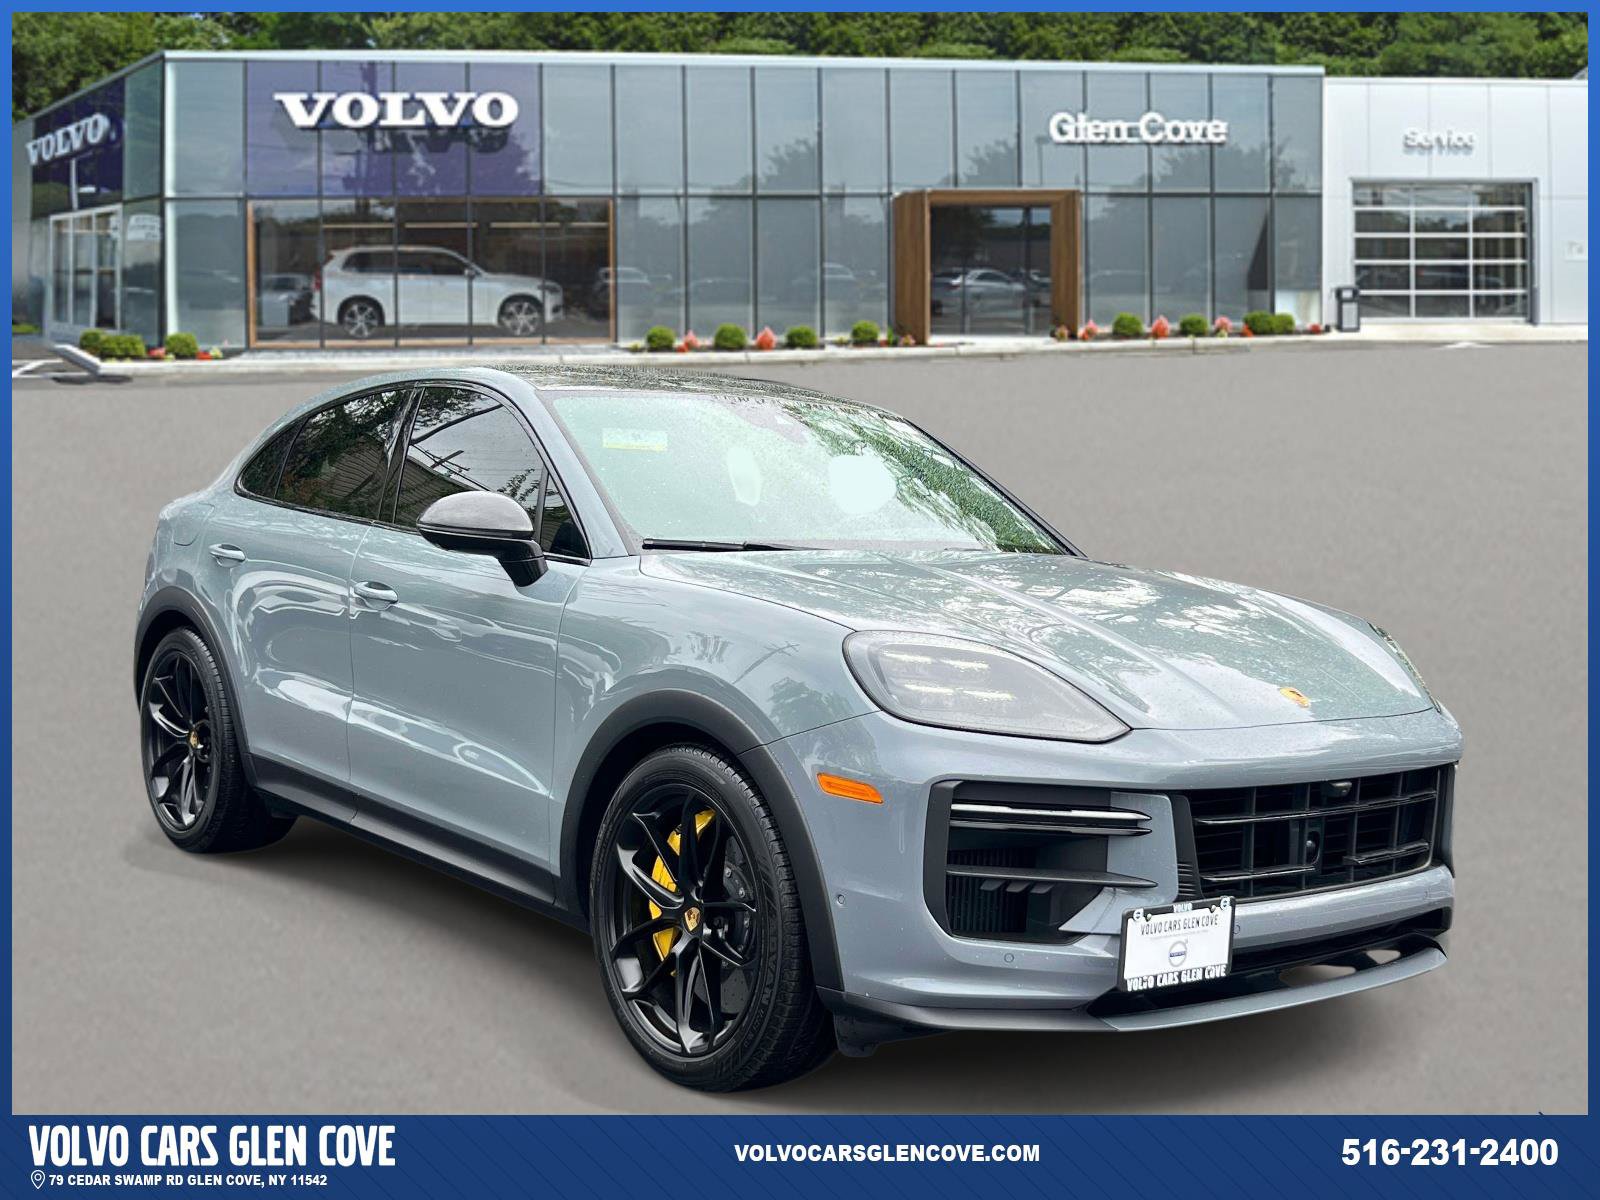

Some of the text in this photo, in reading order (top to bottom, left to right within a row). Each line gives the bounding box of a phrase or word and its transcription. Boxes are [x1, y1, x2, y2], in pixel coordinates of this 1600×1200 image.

[274, 92, 519, 128] VOLVO
[25, 112, 110, 166] VOLVO
[1049, 112, 1228, 145] Glen Cove
[1401, 127, 1477, 151] Service
[1172, 902, 1193, 914] VOLVO
[1141, 921, 1162, 936] VOLVO
[1164, 919, 1181, 933] CARS
[1183, 917, 1200, 930] GLEN
[1201, 914, 1219, 927] COVE
[1157, 970, 1180, 987] CARS
[1181, 967, 1203, 983] GLEN
[1204, 964, 1227, 980] COVE
